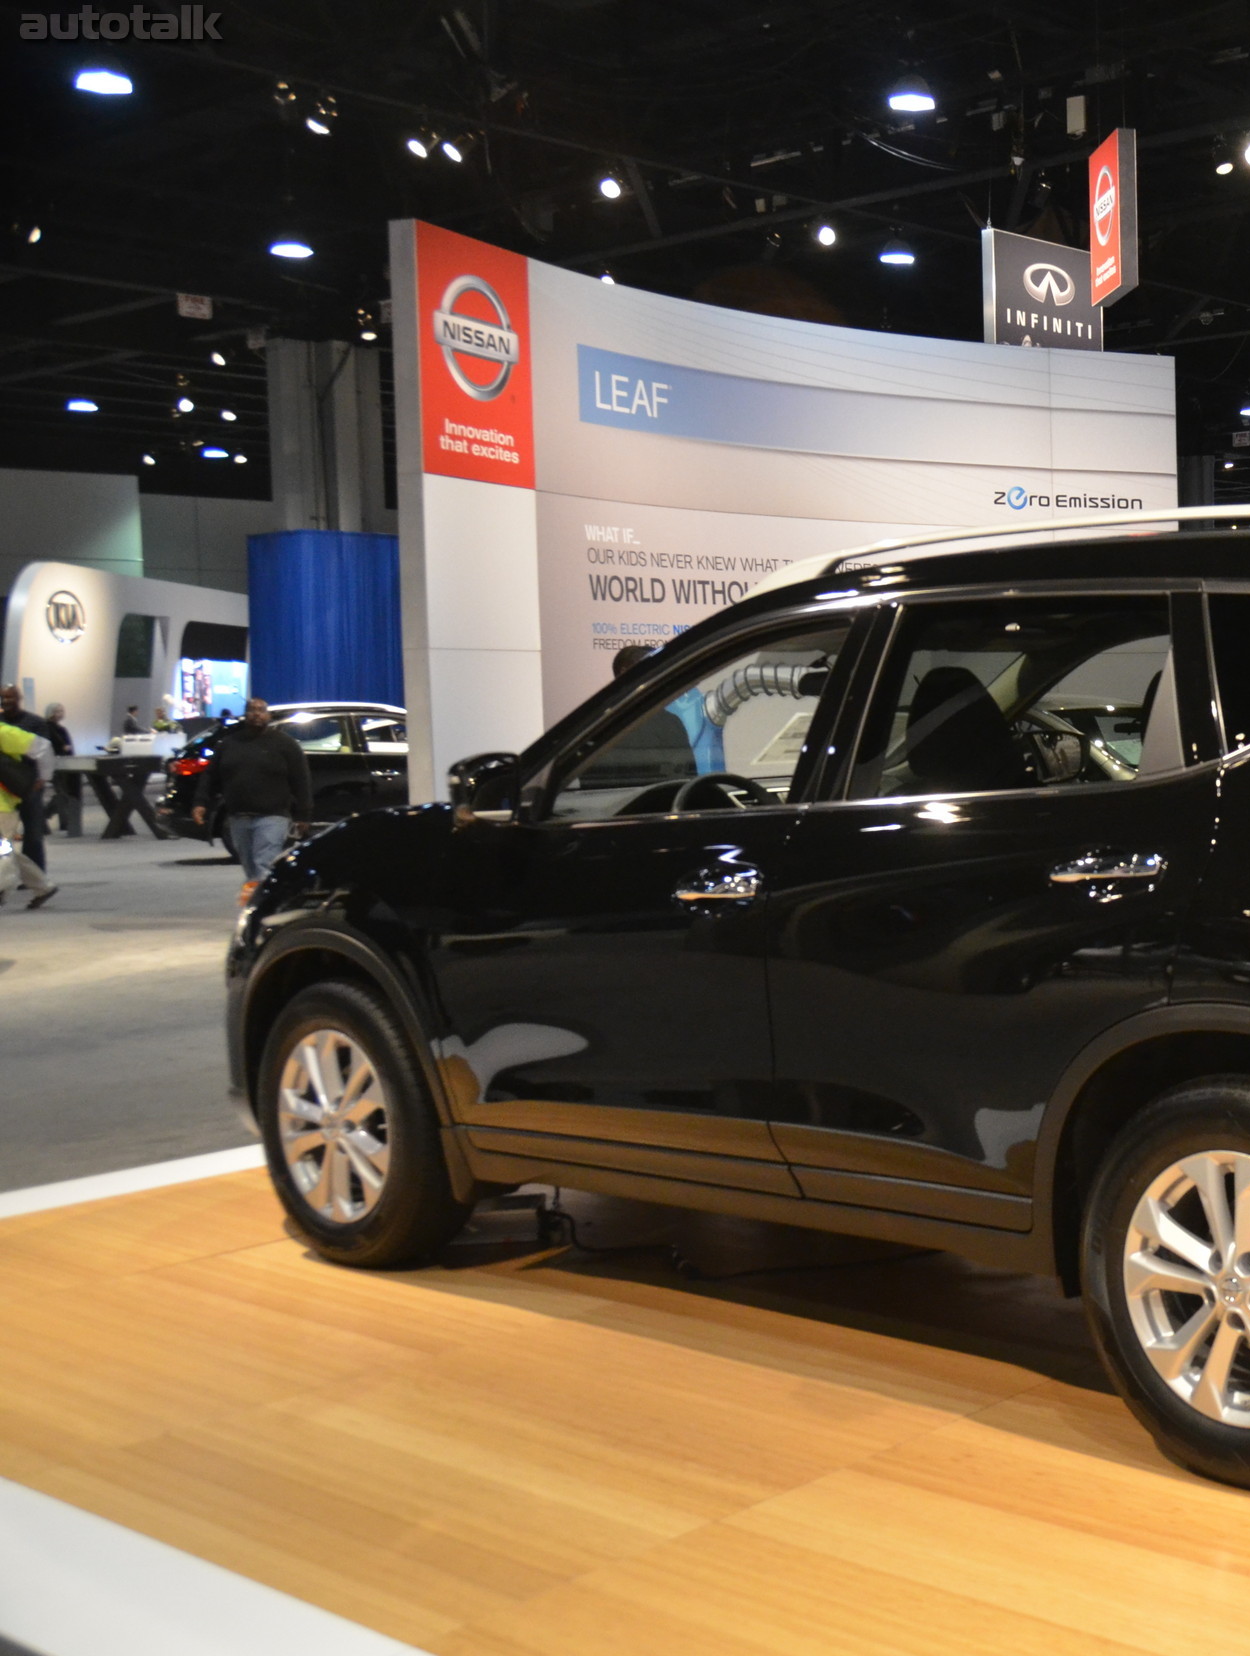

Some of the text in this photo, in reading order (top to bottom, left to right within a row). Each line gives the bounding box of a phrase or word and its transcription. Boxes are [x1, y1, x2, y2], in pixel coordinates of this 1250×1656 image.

[442, 319, 511, 356] NISSAN
[1006, 308, 1092, 340] INFINITI
[594, 370, 669, 418] LEAF
[444, 418, 514, 447] Innovation
[439, 435, 520, 464] that excites
[1055, 493, 1143, 510] Emission
[584, 524, 619, 543] WHAT
[587, 547, 615, 565] OUR
[618, 550, 647, 567] KIDS
[650, 552, 693, 570] NEVER
[696, 555, 737, 571] KNEW
[739, 556, 778, 573] WHAT
[588, 574, 666, 603] WORLD
[592, 622, 617, 635] 100%
[620, 623, 670, 636] ELECTRIC
